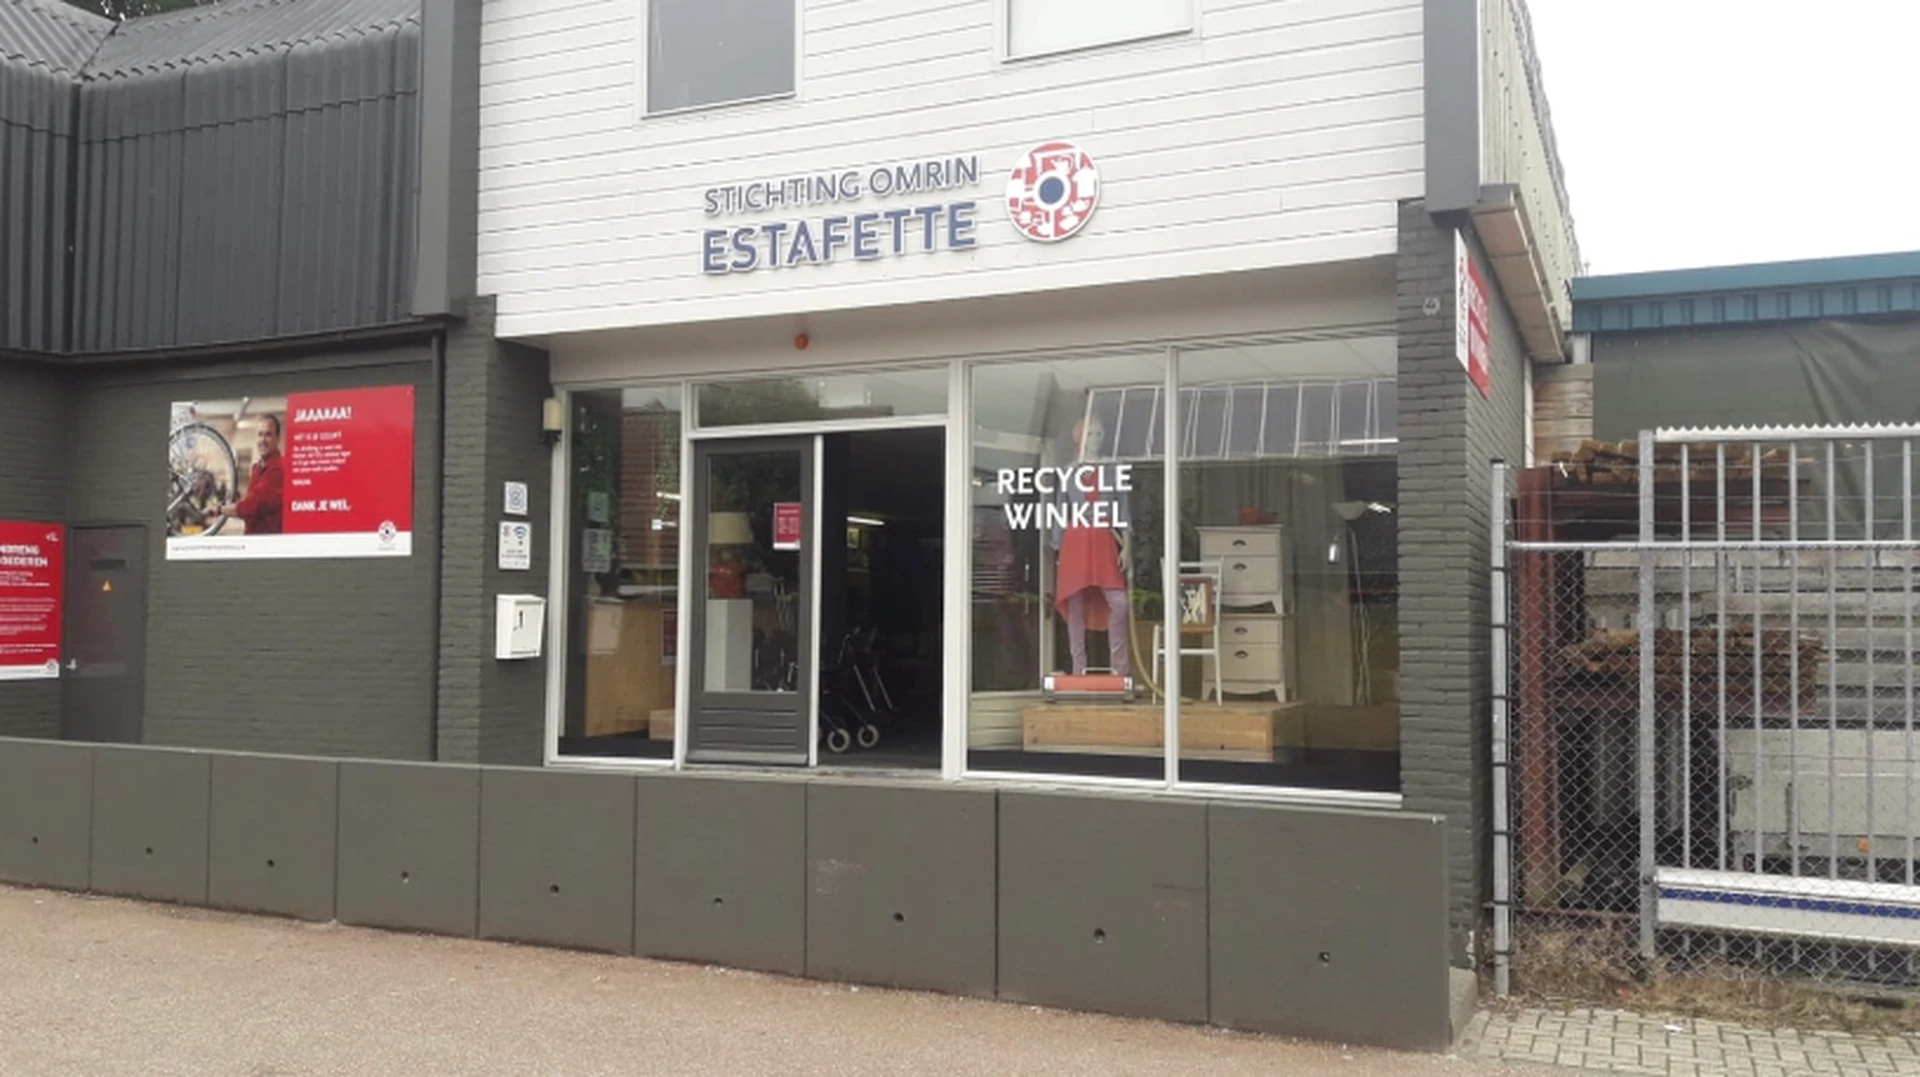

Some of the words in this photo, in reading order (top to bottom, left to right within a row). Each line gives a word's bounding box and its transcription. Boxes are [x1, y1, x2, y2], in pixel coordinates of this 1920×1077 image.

[704, 171, 860, 214] STICHTING
[869, 155, 978, 195] OMRIN
[702, 201, 977, 273] ESTAFETTE
[997, 464, 1133, 495] RECYCLE
[291, 499, 316, 512] DANK
[317, 499, 328, 512] JE
[1004, 501, 1128, 531] WINKEL
